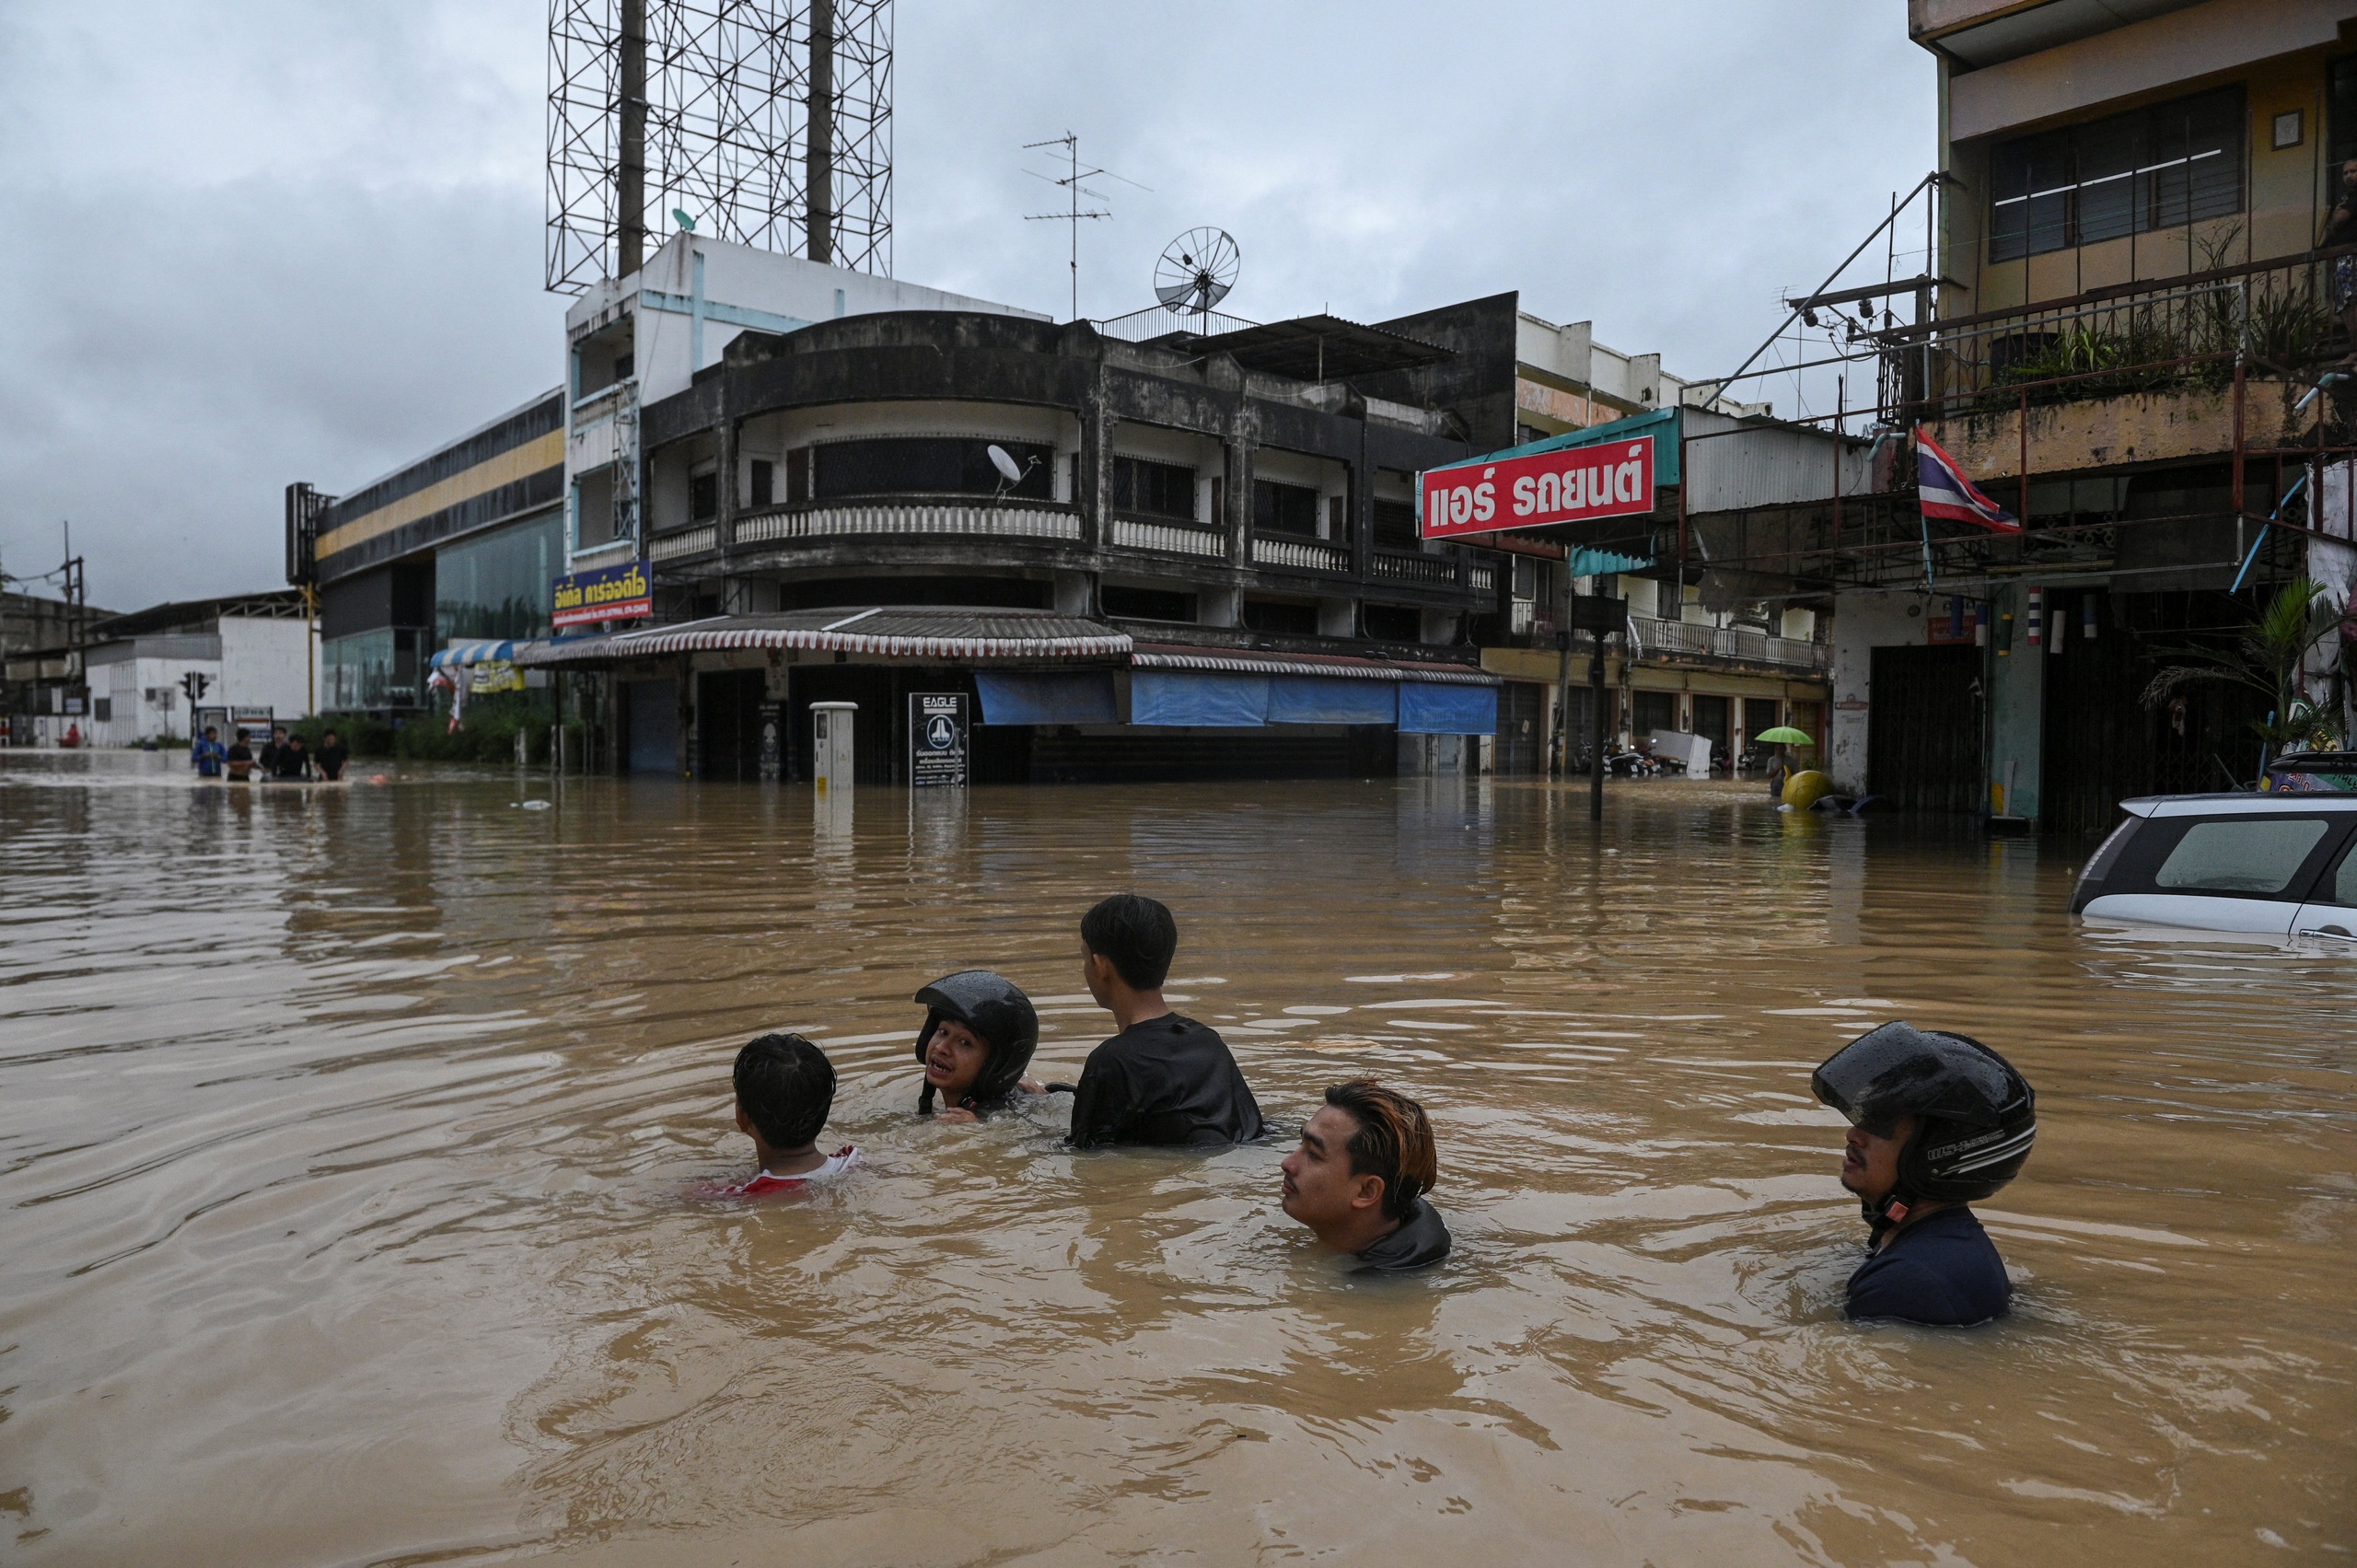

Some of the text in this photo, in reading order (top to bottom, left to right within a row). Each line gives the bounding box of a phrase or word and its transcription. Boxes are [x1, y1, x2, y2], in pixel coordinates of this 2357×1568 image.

[1430, 444, 1643, 528] แอร์ รถยนต์
[923, 697, 958, 708] EAGLE
